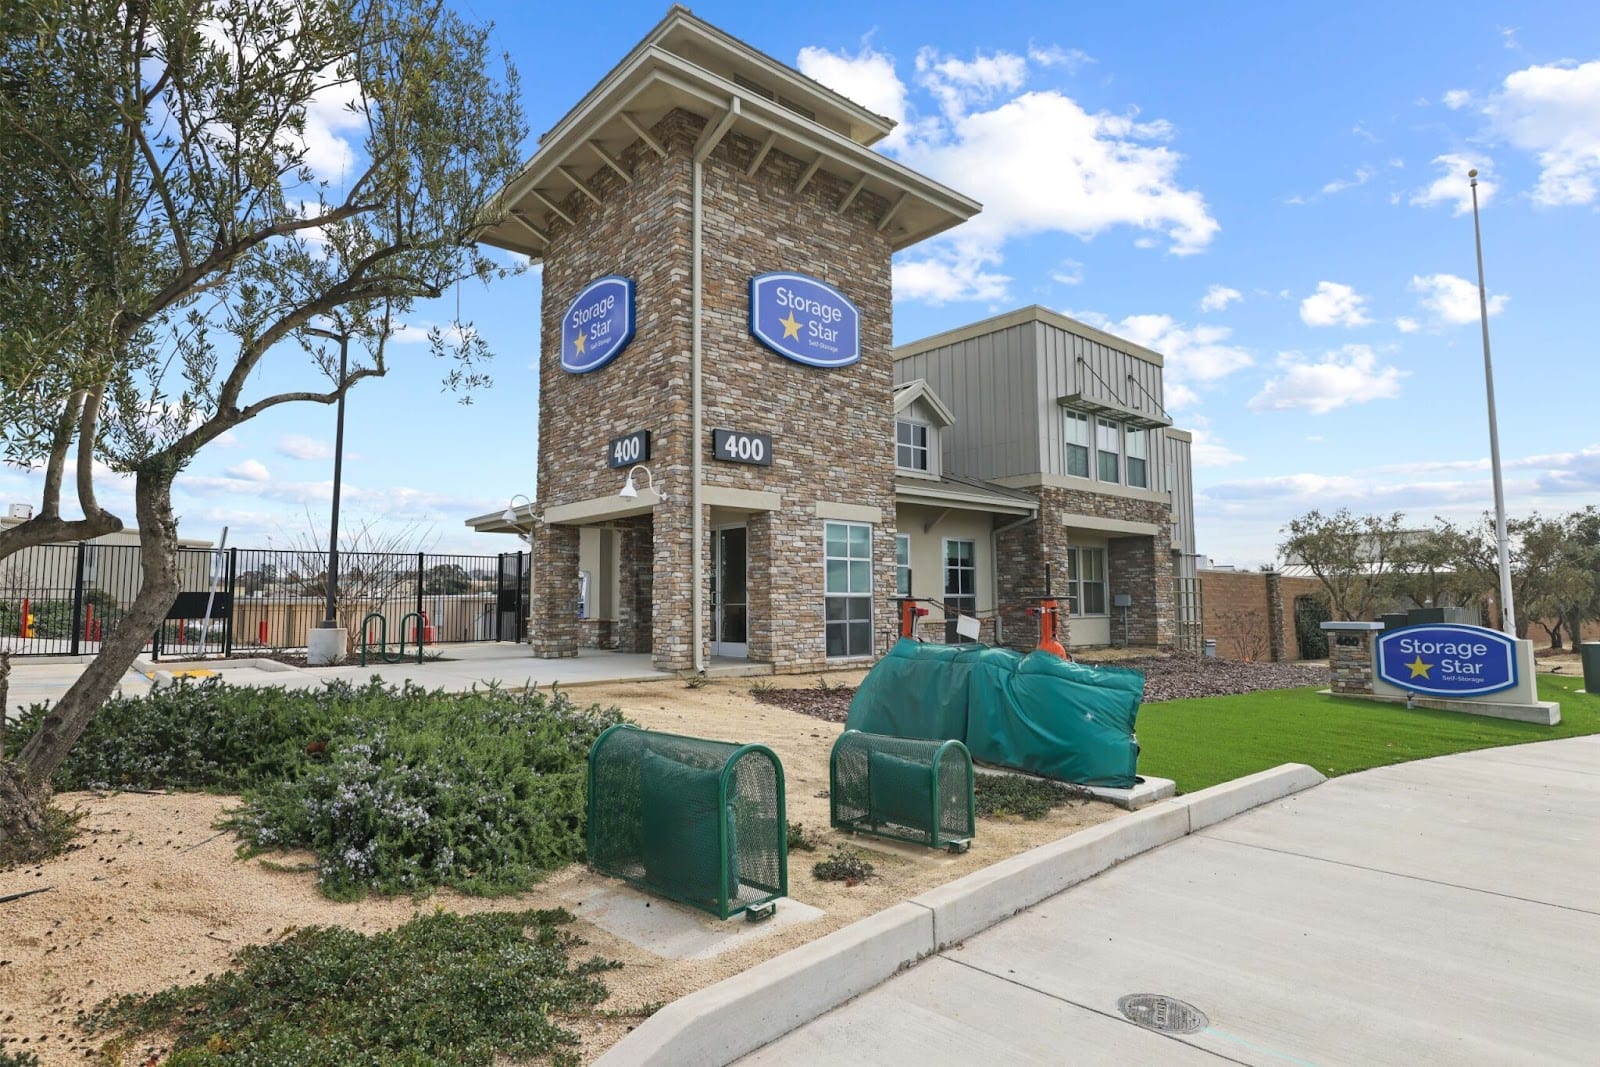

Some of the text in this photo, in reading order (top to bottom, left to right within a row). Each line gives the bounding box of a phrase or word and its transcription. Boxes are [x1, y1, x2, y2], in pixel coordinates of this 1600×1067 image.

[572, 295, 615, 329] Storage
[776, 286, 842, 323] Storage
[590, 319, 612, 340] Star
[808, 320, 839, 342] Star
[614, 437, 640, 463] 400
[725, 435, 764, 461] 400
[1400, 638, 1488, 660] Storage
[1441, 659, 1483, 675] Star
